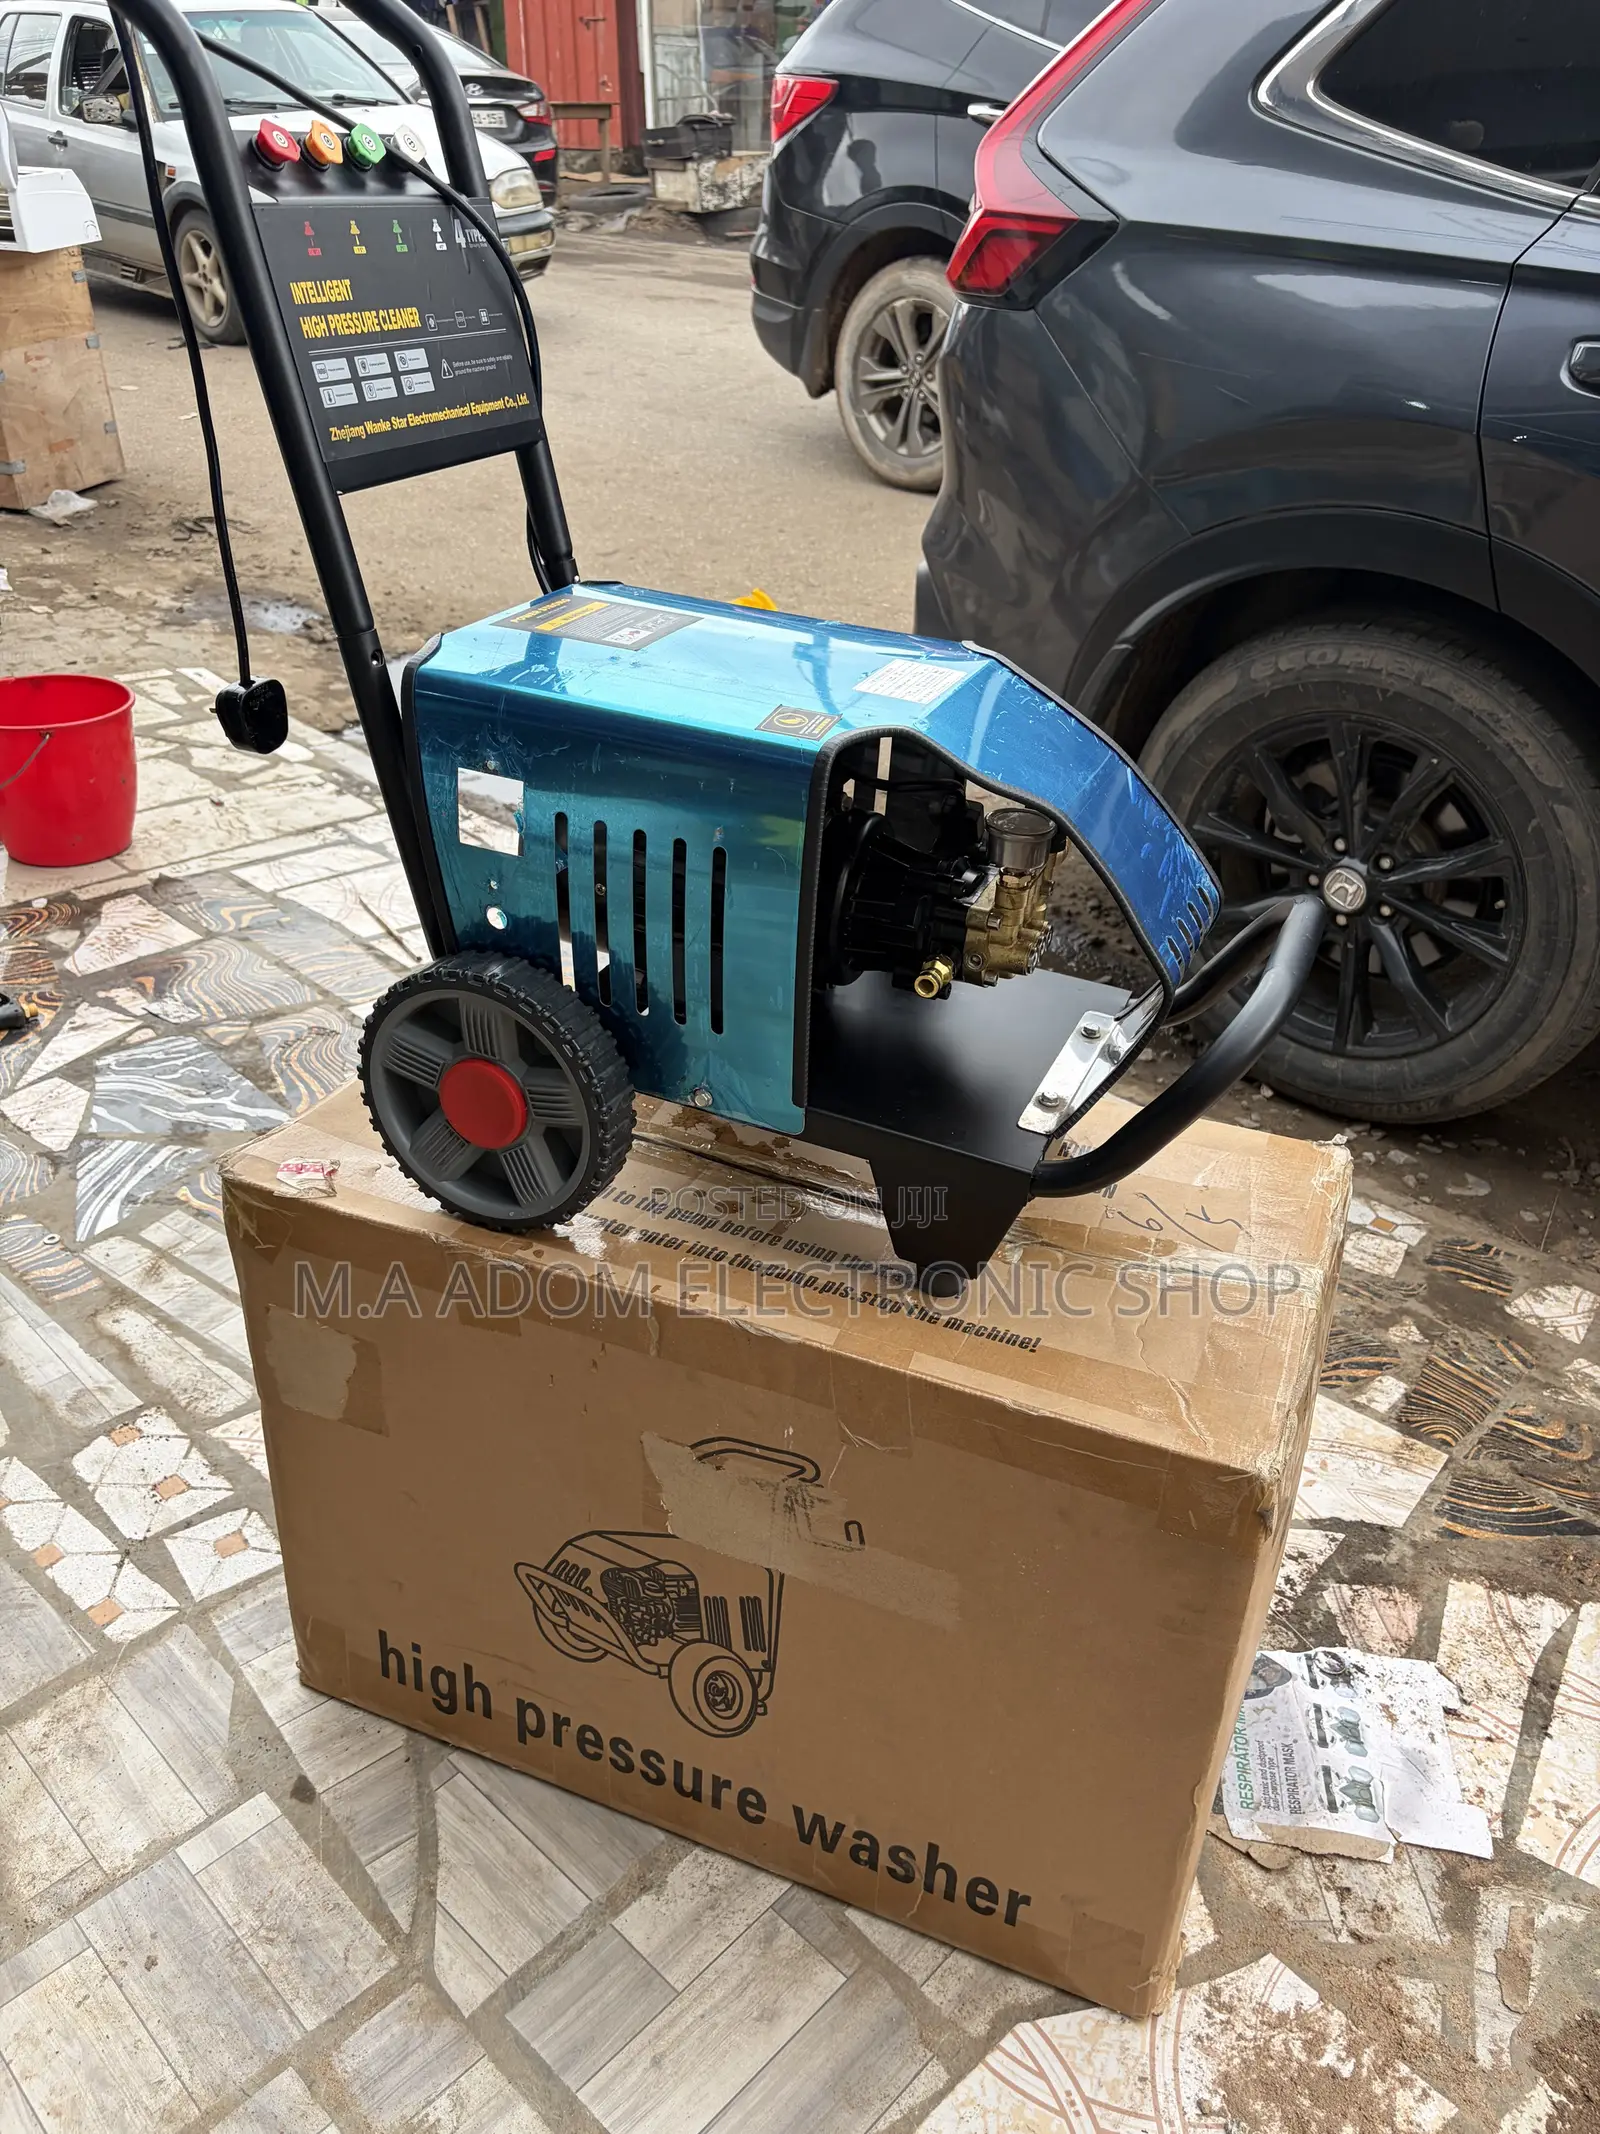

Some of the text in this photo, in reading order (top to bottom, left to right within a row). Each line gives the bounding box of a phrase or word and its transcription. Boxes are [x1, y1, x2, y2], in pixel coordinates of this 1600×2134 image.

[454, 218, 467, 249] 4
[289, 279, 354, 304] INTELLIGENT
[299, 307, 422, 339] HIGH PRESSURE CLEANER
[329, 424, 365, 441] Zhejiang
[364, 419, 392, 435] Wanke
[391, 416, 408, 430] Star
[407, 403, 471, 426] Electromechanical
[470, 397, 505, 417] Equipment
[517, 393, 530, 406] Ltd.
[613, 1190, 636, 1205] to
[634, 1196, 668, 1215] the
[664, 1206, 720, 1230] pump
[718, 1220, 783, 1247] before
[781, 1237, 838, 1263] using
[837, 1253, 876, 1273] the
[636, 1228, 689, 1251] enter
[686, 1241, 729, 1263] into
[727, 1252, 763, 1273] the
[905, 1302, 942, 1325] the
[942, 1315, 1042, 1354] machine!
[378, 1628, 1033, 1928] high pressure washer
[1234, 1727, 1255, 1811] RESPIRATOR
[1281, 1742, 1302, 1815] RESPIRATOR MASK
